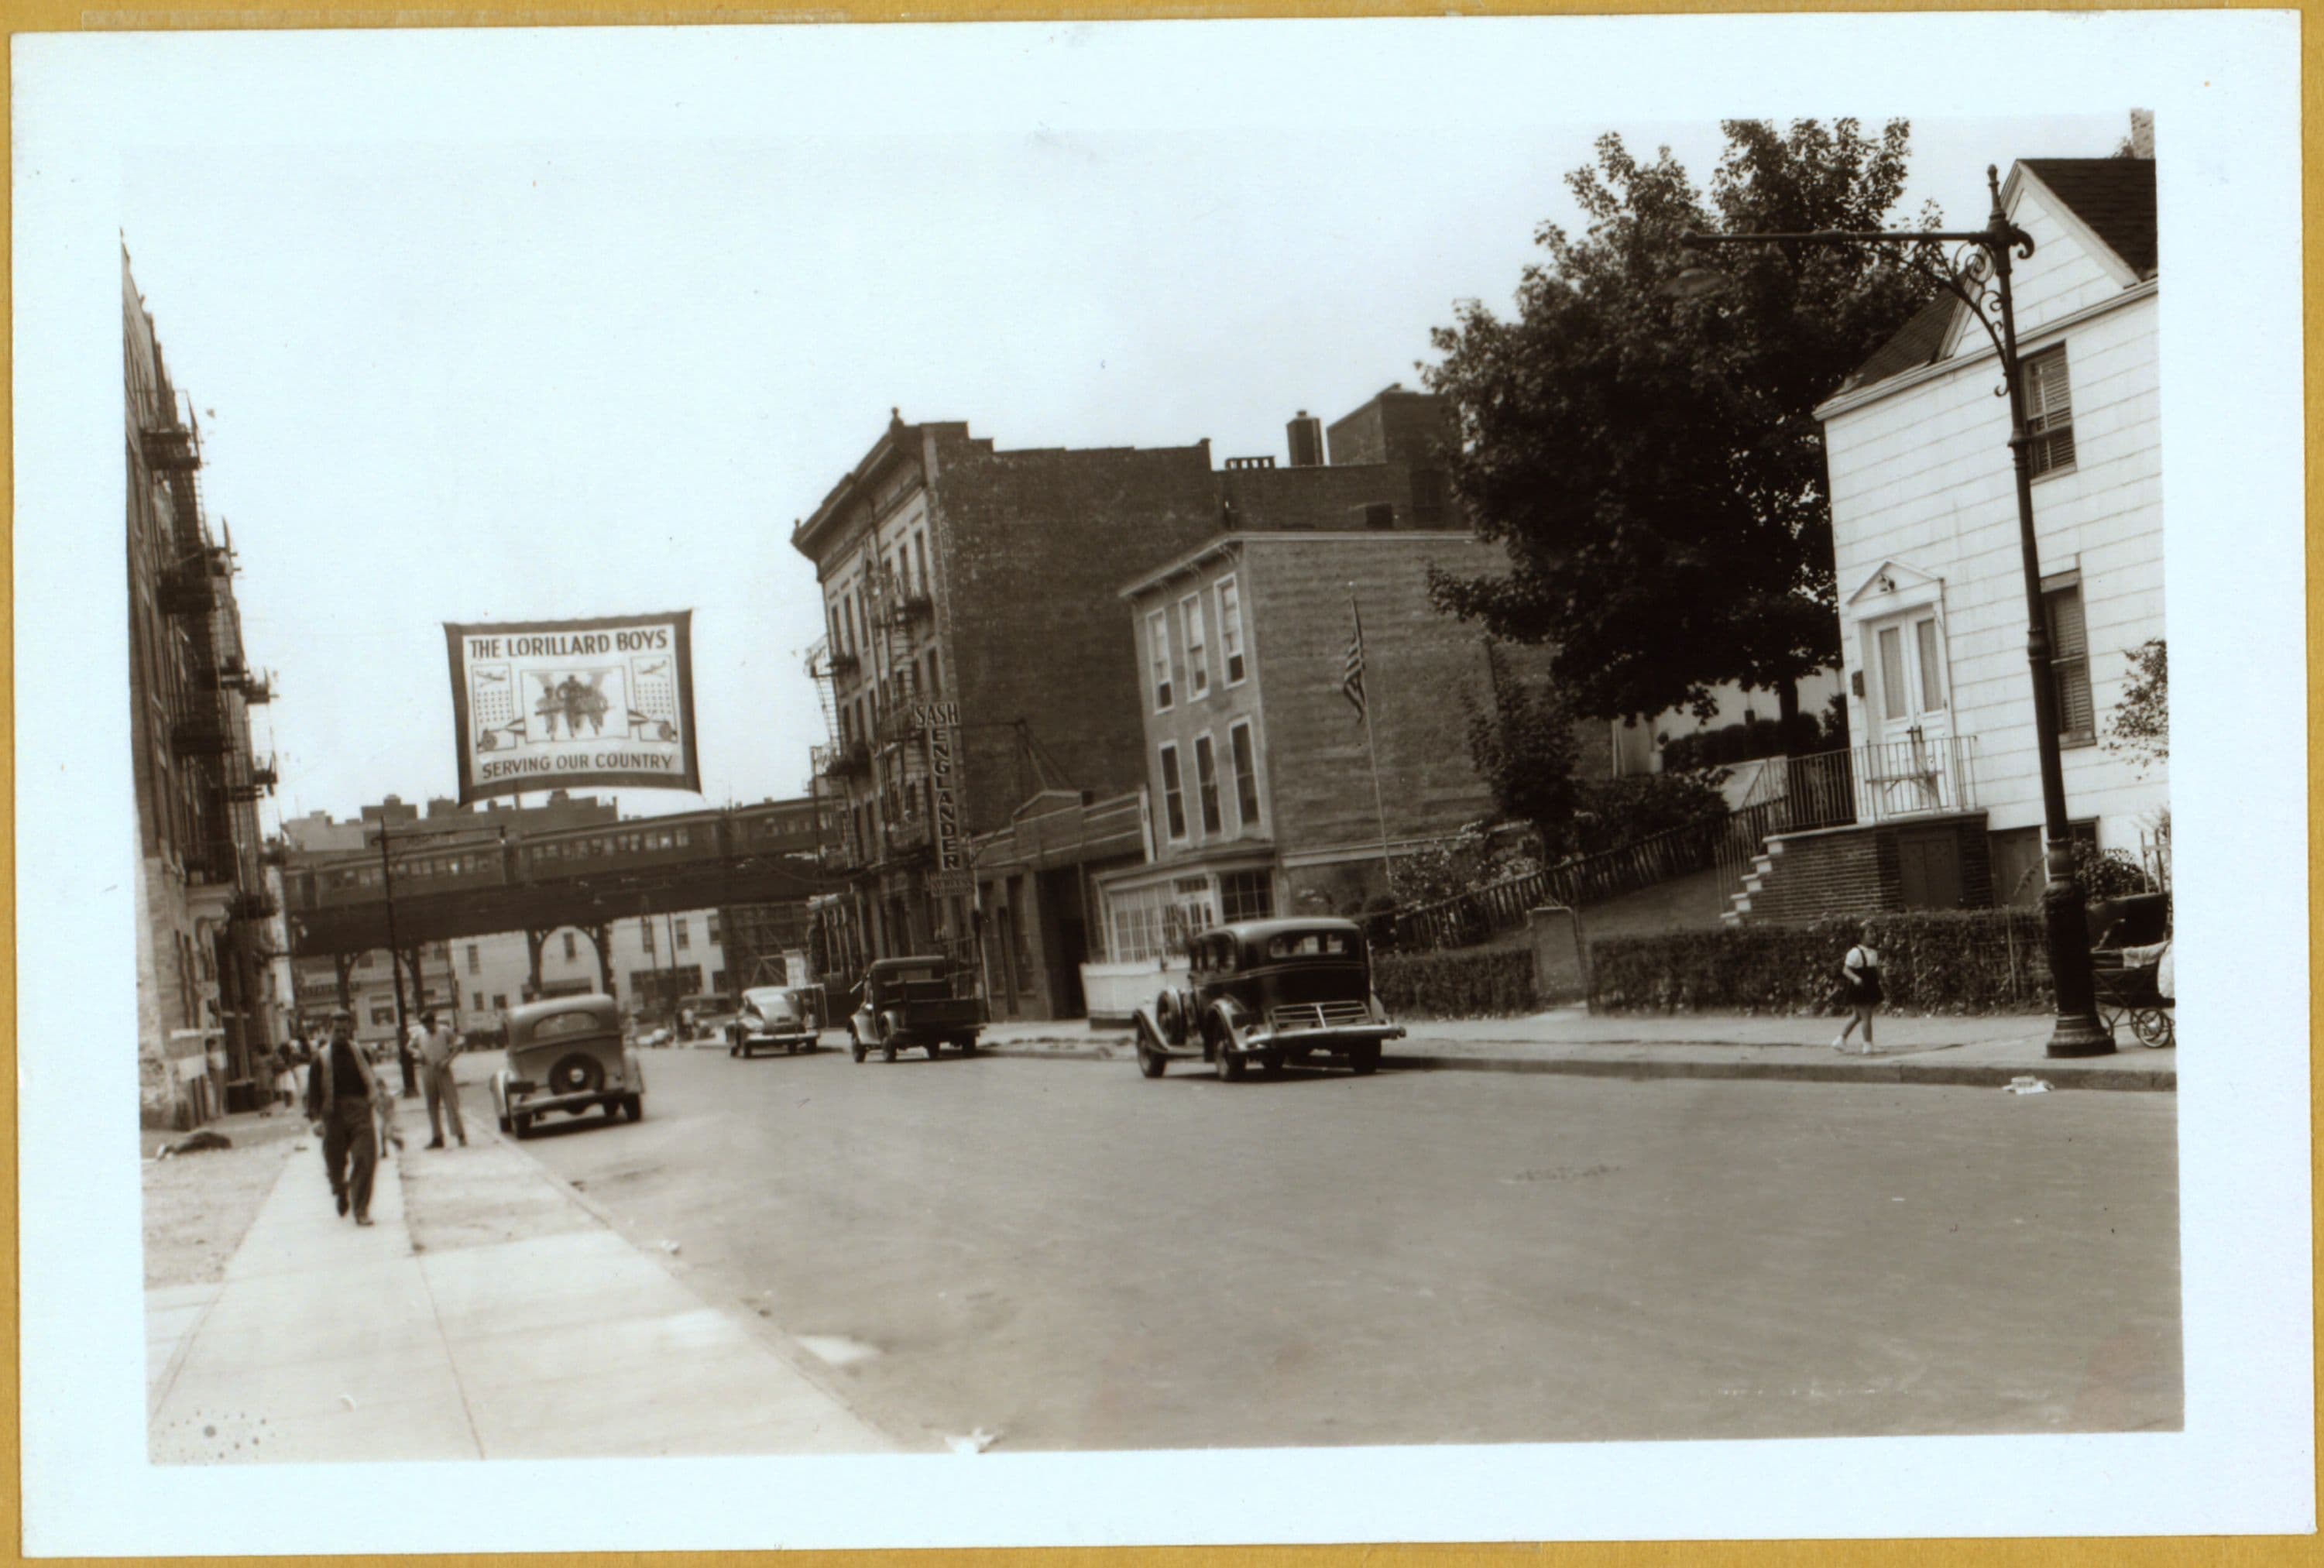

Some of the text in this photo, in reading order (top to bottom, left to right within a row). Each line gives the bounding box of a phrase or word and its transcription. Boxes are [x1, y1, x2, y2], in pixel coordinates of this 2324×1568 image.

[469, 630, 667, 659] THE LORILLARD BOYS
[915, 703, 959, 726] SASH
[482, 754, 673, 780] SERVING OUR COUNTRY
[932, 728, 960, 870] ENGLANDER
